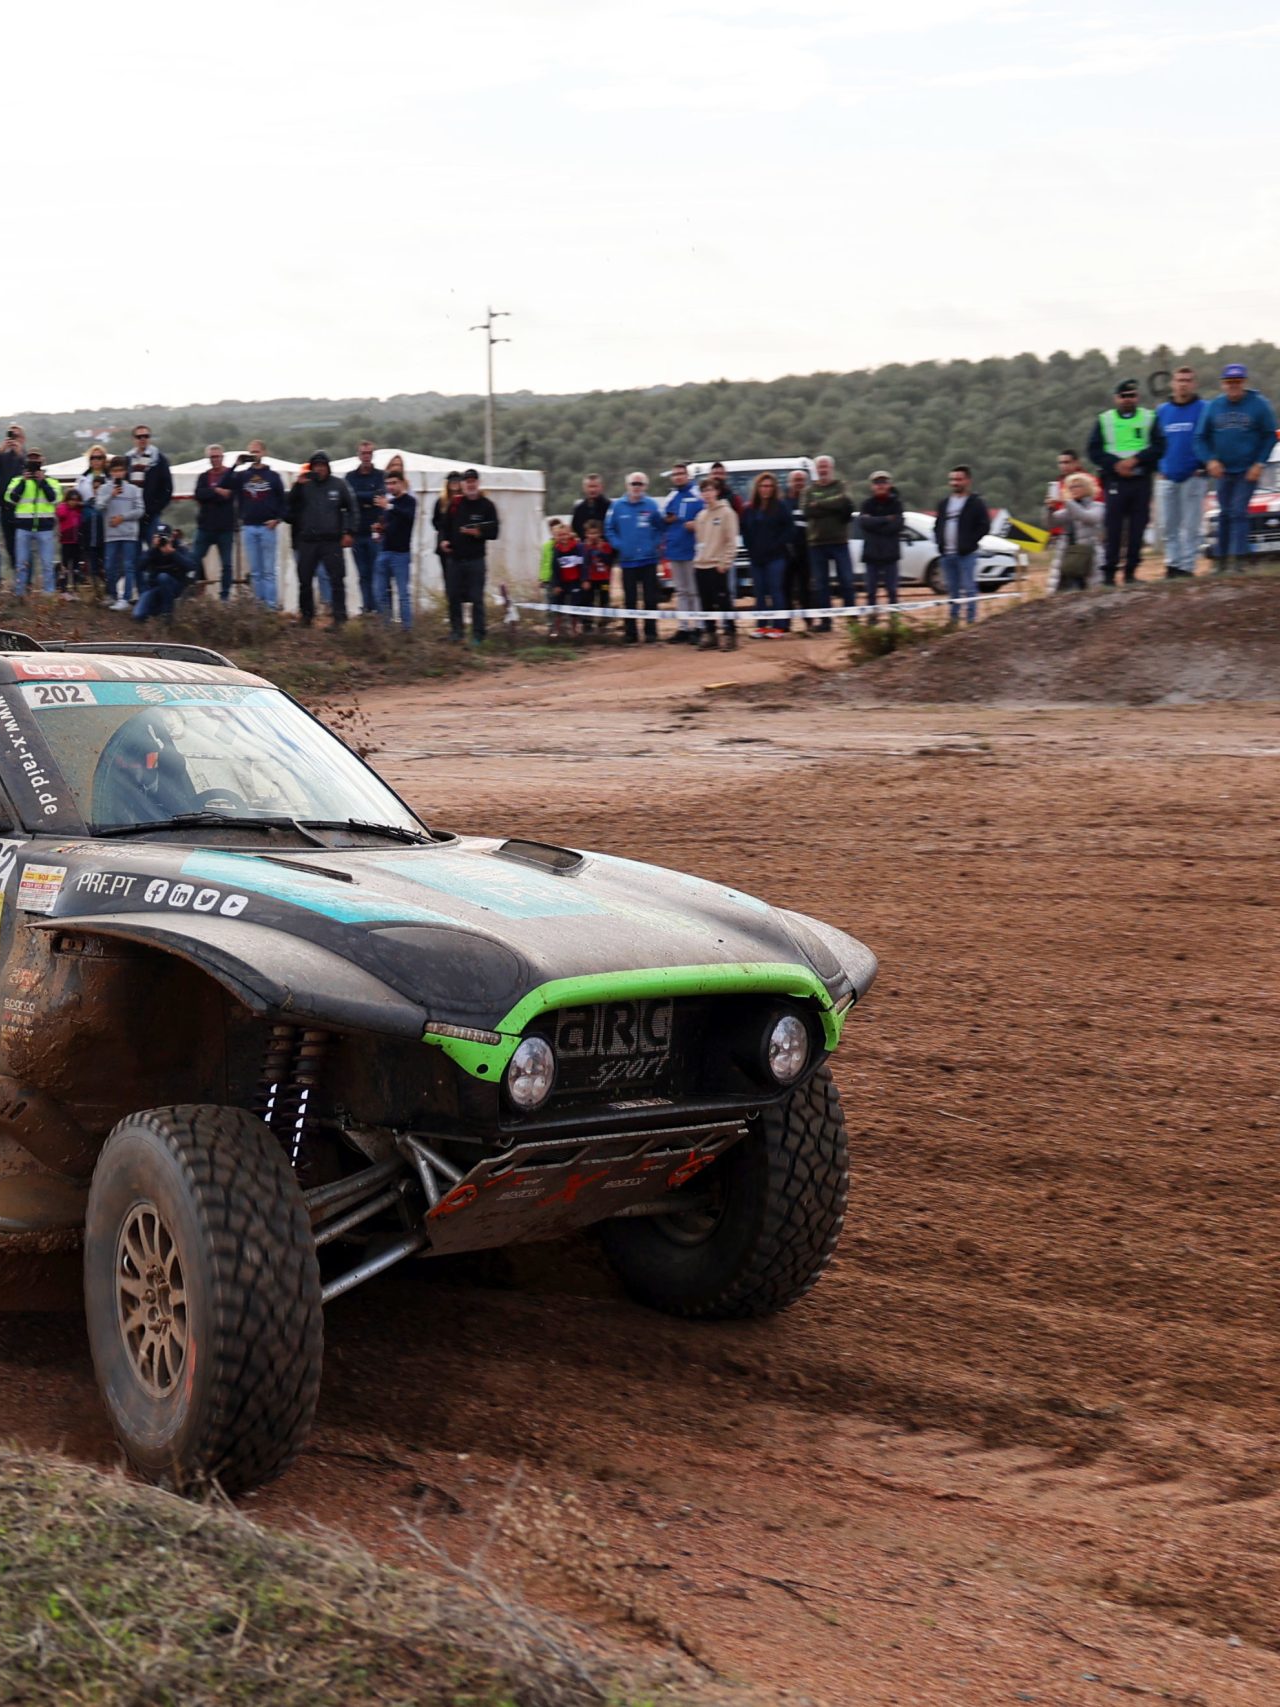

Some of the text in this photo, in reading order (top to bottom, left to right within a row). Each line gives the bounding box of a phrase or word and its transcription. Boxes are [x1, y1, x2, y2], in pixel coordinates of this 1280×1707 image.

[22, 664, 86, 678] acp
[34, 685, 85, 704] 202
[76, 872, 137, 897] PRF.PT
[590, 1050, 669, 1089] sport
